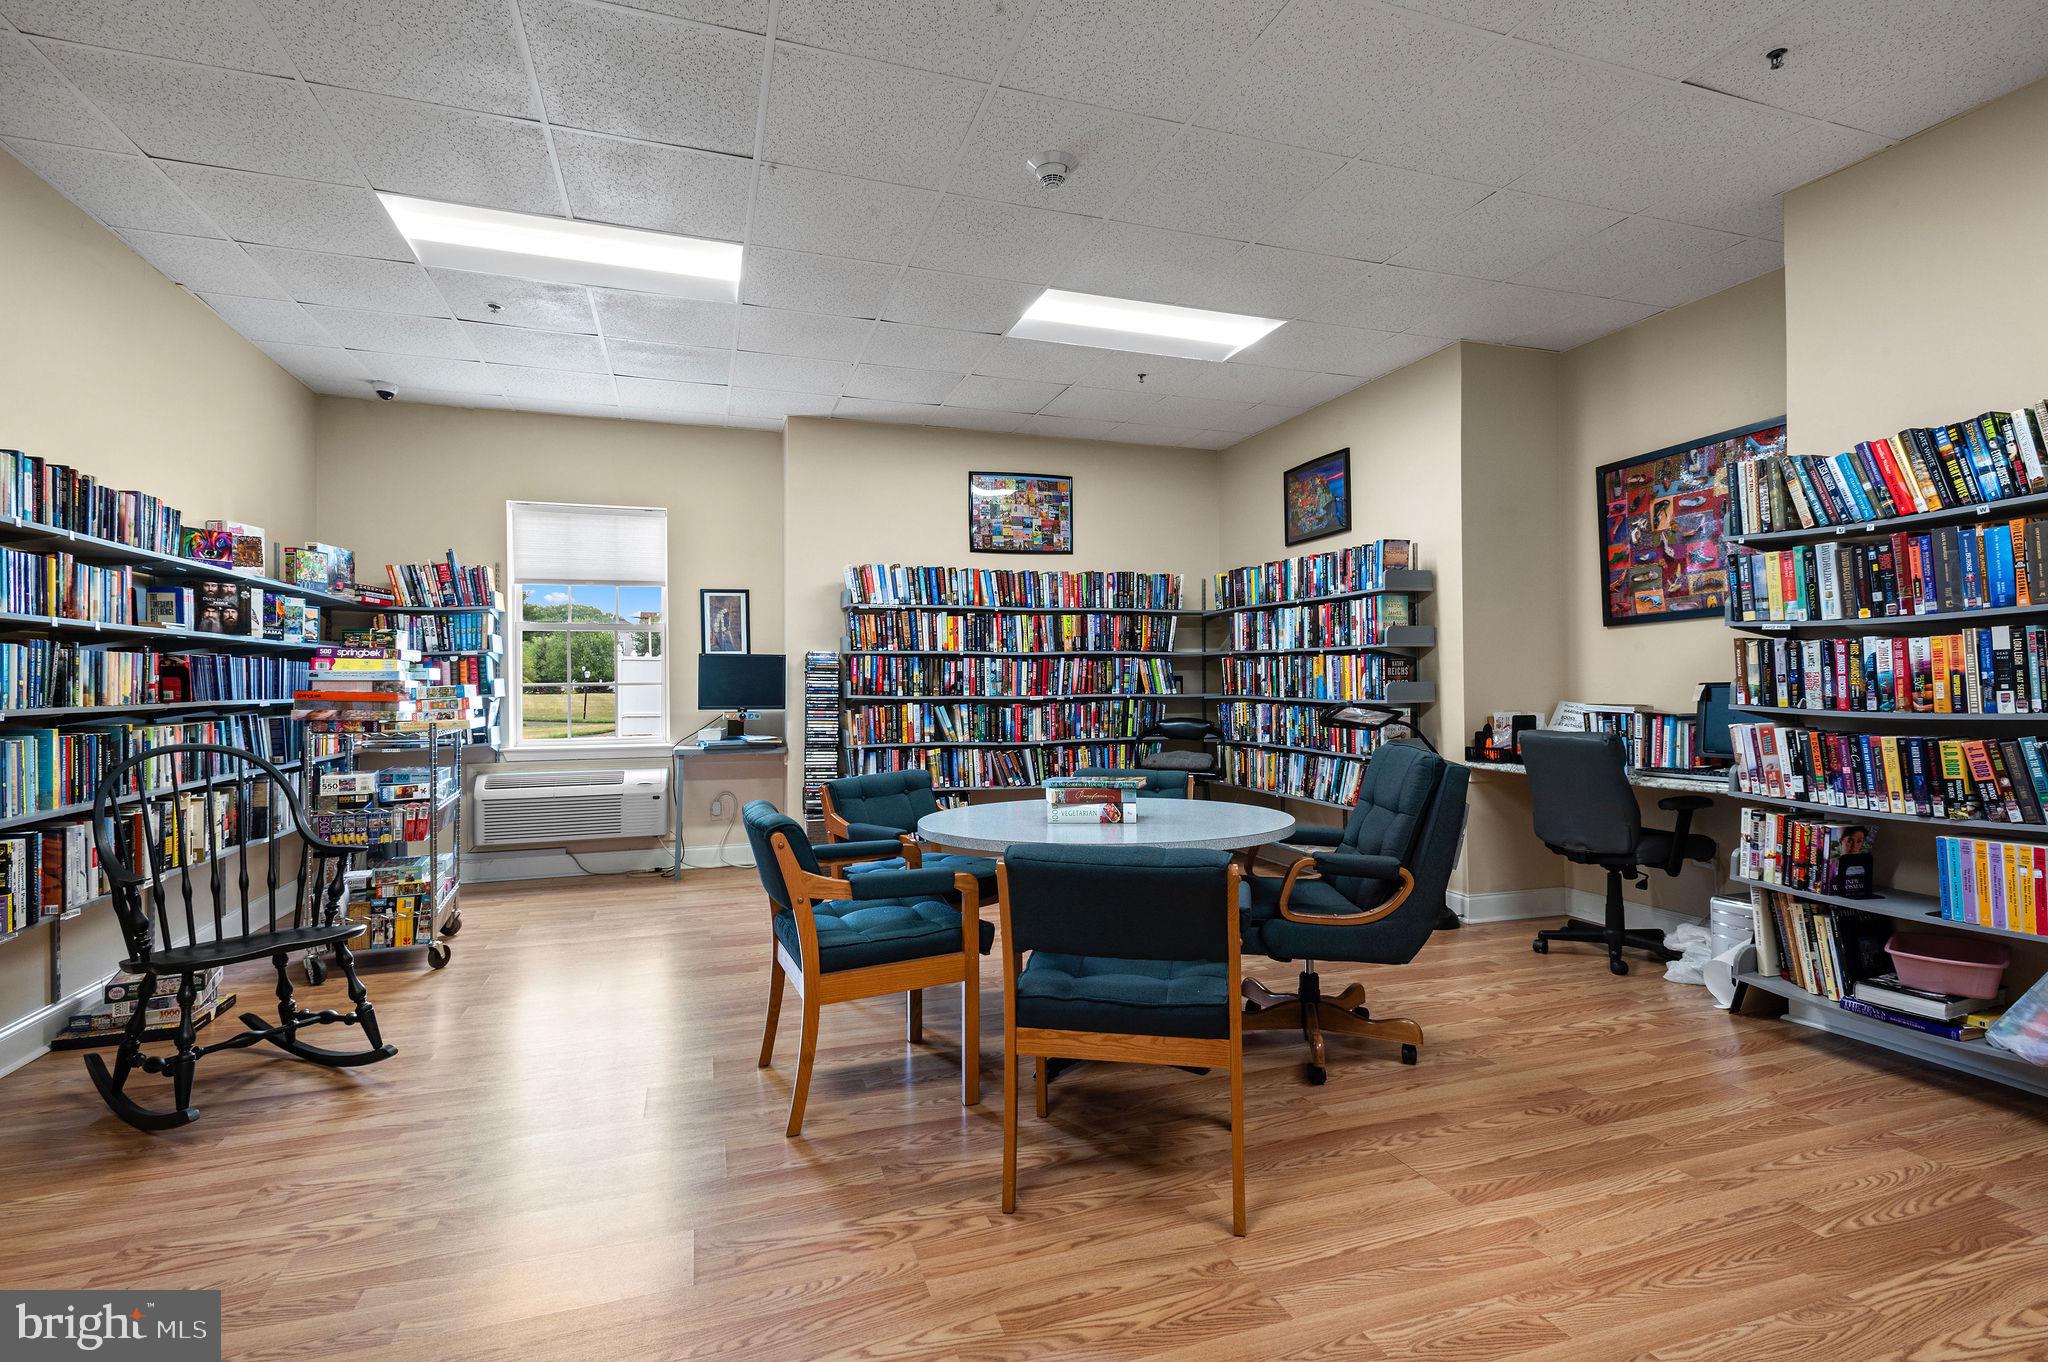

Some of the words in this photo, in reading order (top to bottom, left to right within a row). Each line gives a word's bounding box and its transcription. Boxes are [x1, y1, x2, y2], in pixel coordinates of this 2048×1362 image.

[1965, 423, 1976, 446] STEPHEN
[1917, 432, 1928, 447] KATE
[1923, 447, 1936, 467] WHITE
[1947, 460, 1960, 477] NIGHT
[1953, 479, 1968, 498] MOVES
[1821, 545, 1830, 564] DAVID
[1822, 563, 1832, 591] BALDACCI
[2017, 570, 2027, 597] PERSONAL
[1808, 584, 1816, 610] OMENS
[336, 648, 381, 658] springbok
[1850, 644, 1859, 655] IRIS
[2013, 638, 2022, 651] LORA
[1387, 666, 1409, 676] REICHS
[1850, 656, 1860, 685] JOHANSEN
[1967, 654, 1975, 673] CHARLES
[2016, 670, 2024, 682] HEAT
[2017, 684, 2025, 699] SEEKE
[1945, 759, 1961, 776] ROBB
[1972, 760, 1991, 778] ROBB
[1980, 789, 1989, 801] DEATH
[1987, 783, 1998, 800] FANTASY
[159, 1009, 181, 1019] 1000
